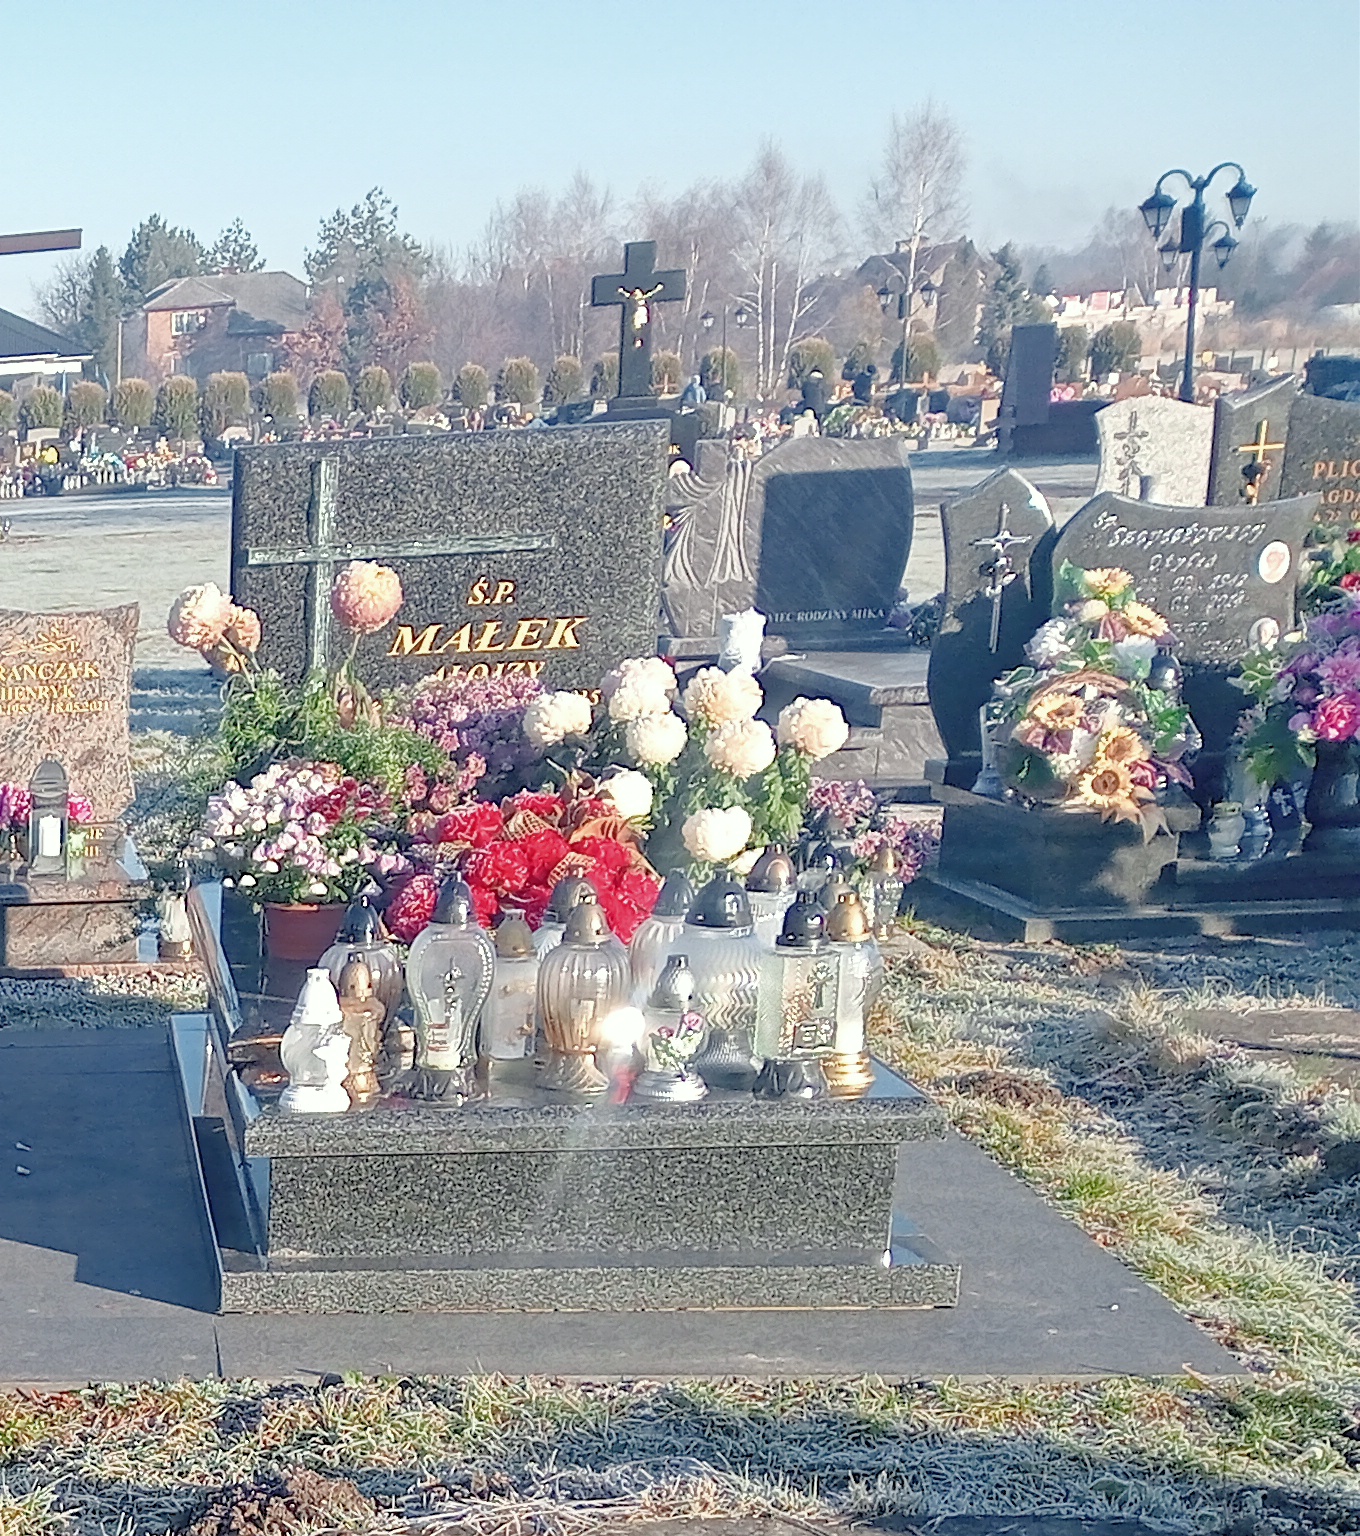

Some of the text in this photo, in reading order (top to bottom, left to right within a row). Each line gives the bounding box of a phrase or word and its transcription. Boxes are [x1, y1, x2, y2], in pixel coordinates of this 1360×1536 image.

[467, 577, 516, 606] Ś.P.
[797, 608, 847, 623] RODZINY
[386, 615, 590, 657] MAŁEK
[0, 685, 77, 701] HENRYK
